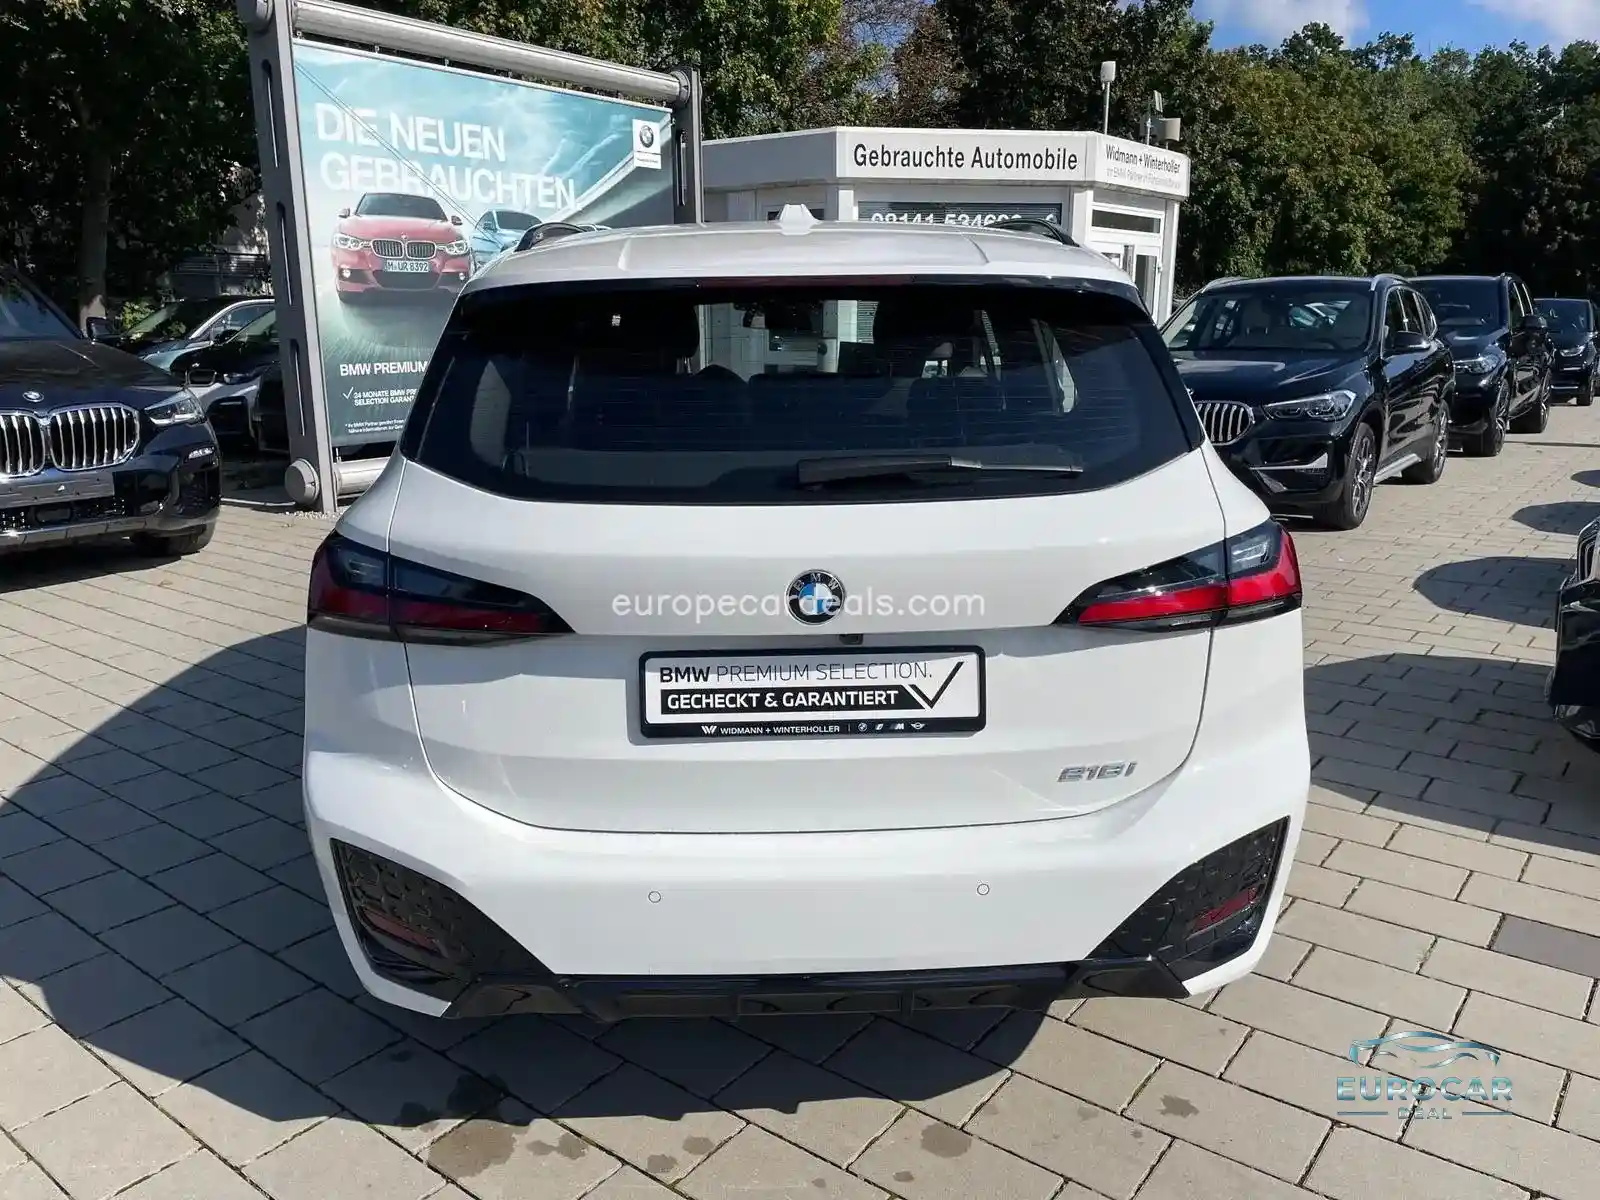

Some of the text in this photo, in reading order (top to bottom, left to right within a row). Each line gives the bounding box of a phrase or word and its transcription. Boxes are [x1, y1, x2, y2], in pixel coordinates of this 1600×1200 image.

[316, 103, 506, 161] DIE NEUEN
[853, 143, 1078, 169] Gebrauchte Automobile
[1106, 144, 1137, 166] Widmann
[320, 151, 577, 210] GEBRAUCHTEN
[339, 361, 428, 376] BMW PREMIUM
[353, 391, 361, 399] 24
[363, 389, 389, 398] MONATE
[390, 388, 405, 397] BMW
[354, 398, 389, 406] SELECTION
[660, 662, 933, 683] BMW PREMIUM SELECTION.
[667, 690, 899, 710] GECHECKT & GARANTIERT
[720, 727, 763, 735] WIDMANN
[772, 725, 840, 734] WINTERHOLLER
